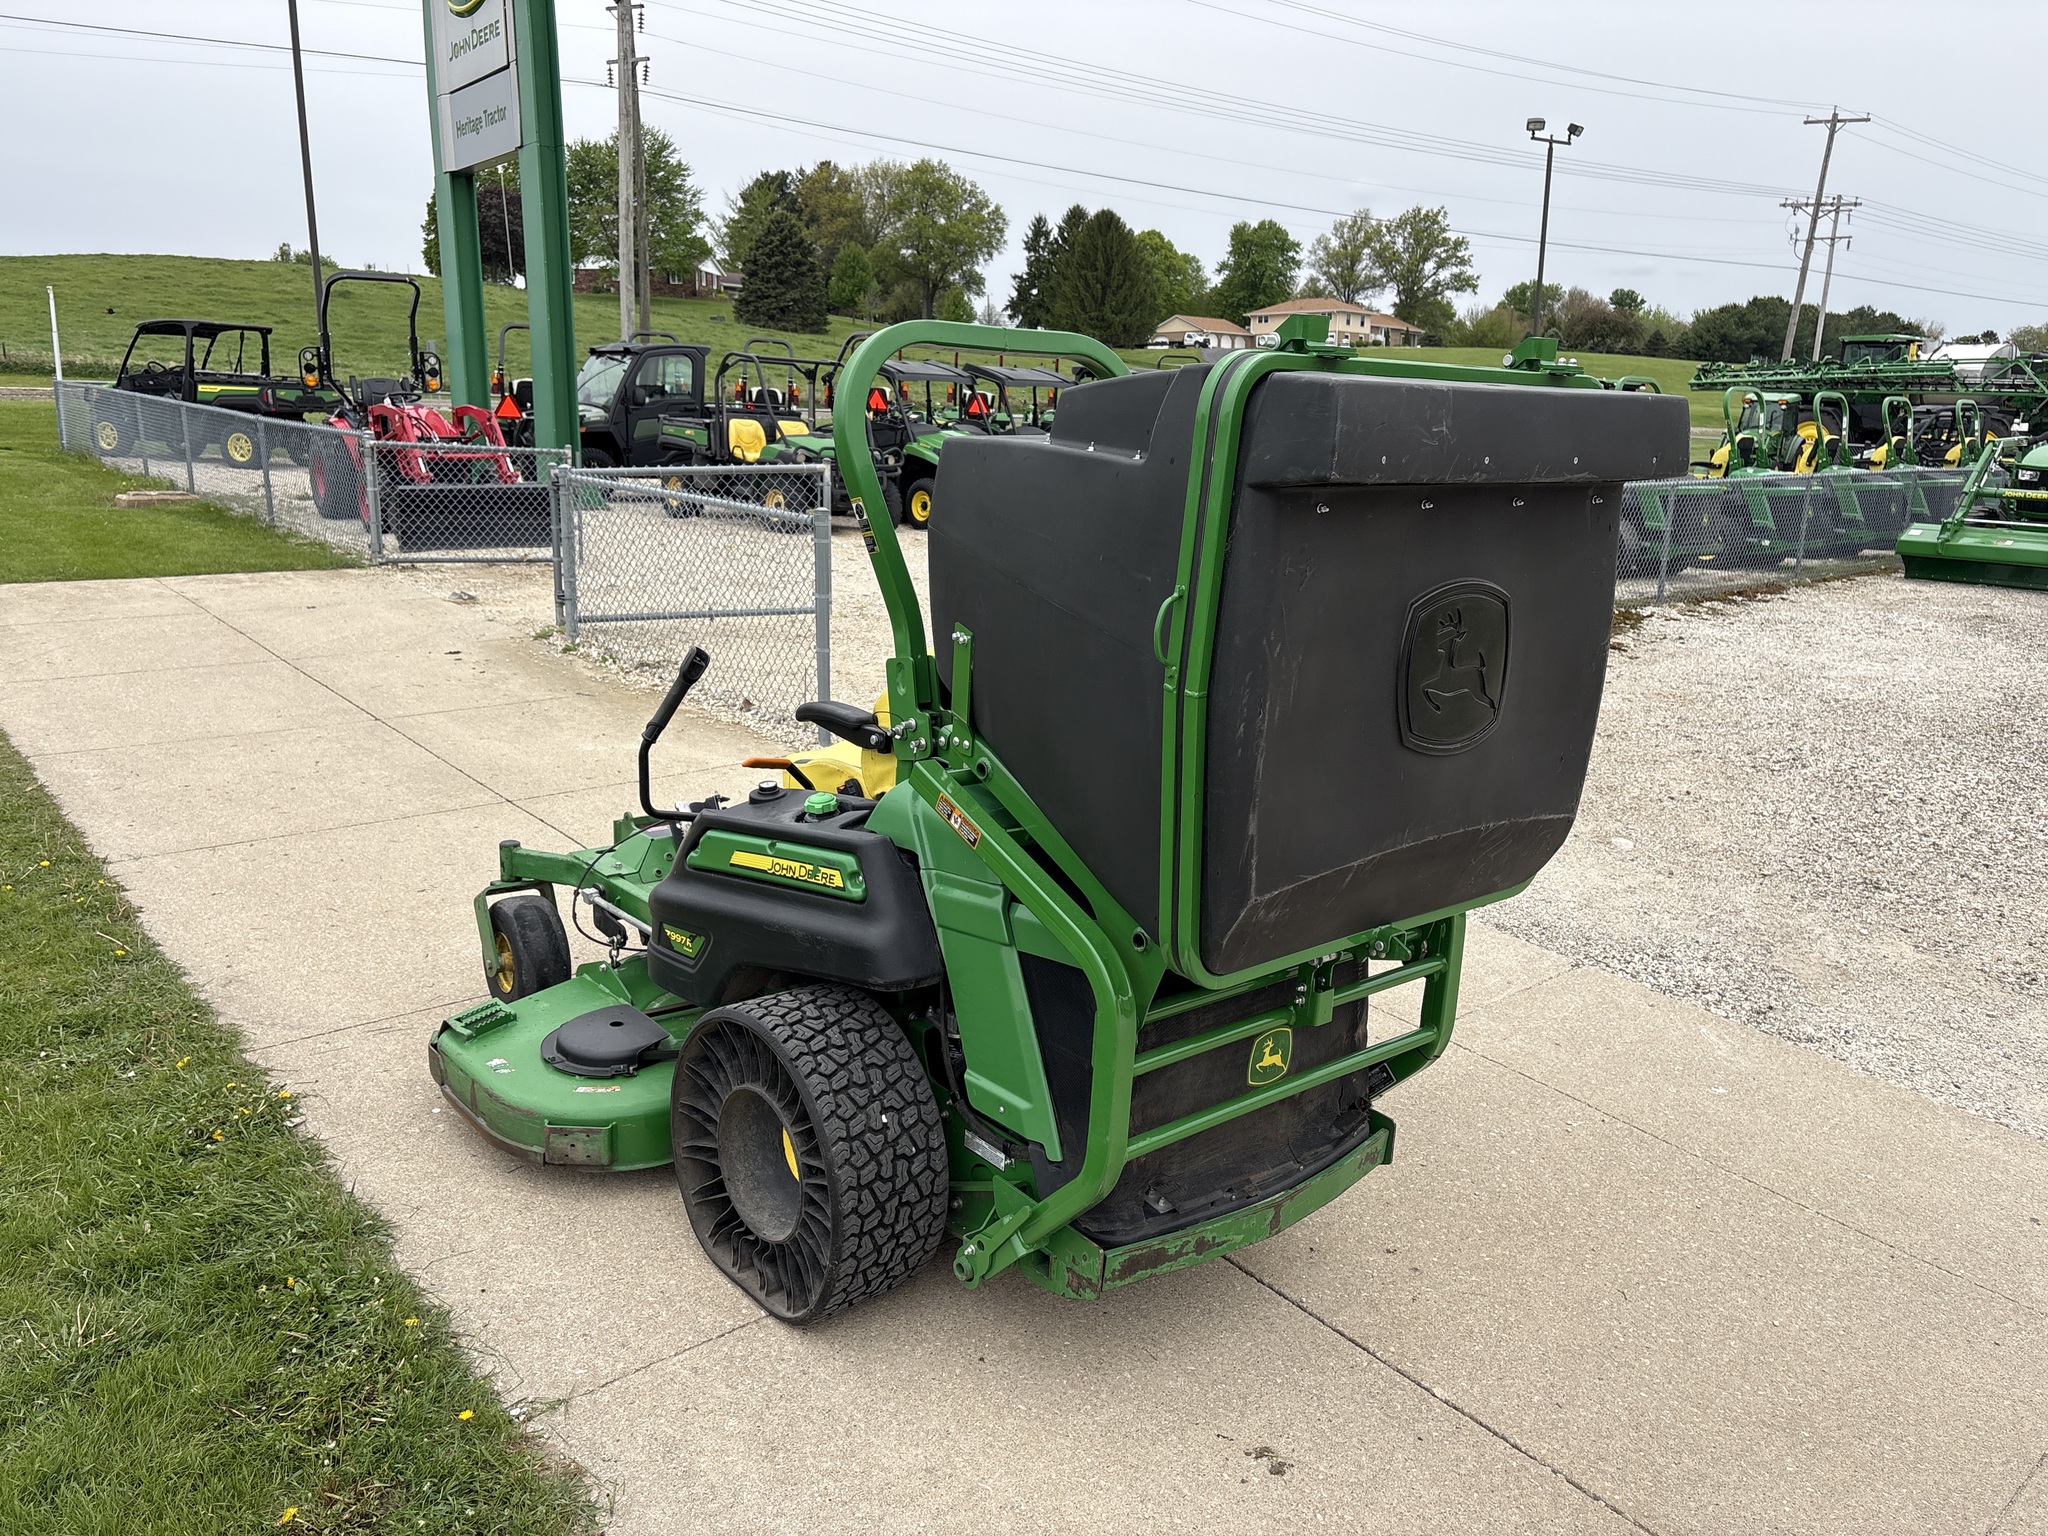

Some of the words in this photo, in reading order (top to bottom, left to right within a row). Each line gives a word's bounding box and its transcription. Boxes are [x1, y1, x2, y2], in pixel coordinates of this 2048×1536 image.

[449, 36, 471, 62] JOHN
[471, 19, 501, 50] DEERE
[456, 115, 483, 139] Heritage
[483, 105, 507, 128] Tractor
[2003, 490, 2024, 498] JOHN
[2025, 491, 2048, 499] DEER
[768, 859, 796, 877] JOHN
[798, 865, 836, 885] DEERE
